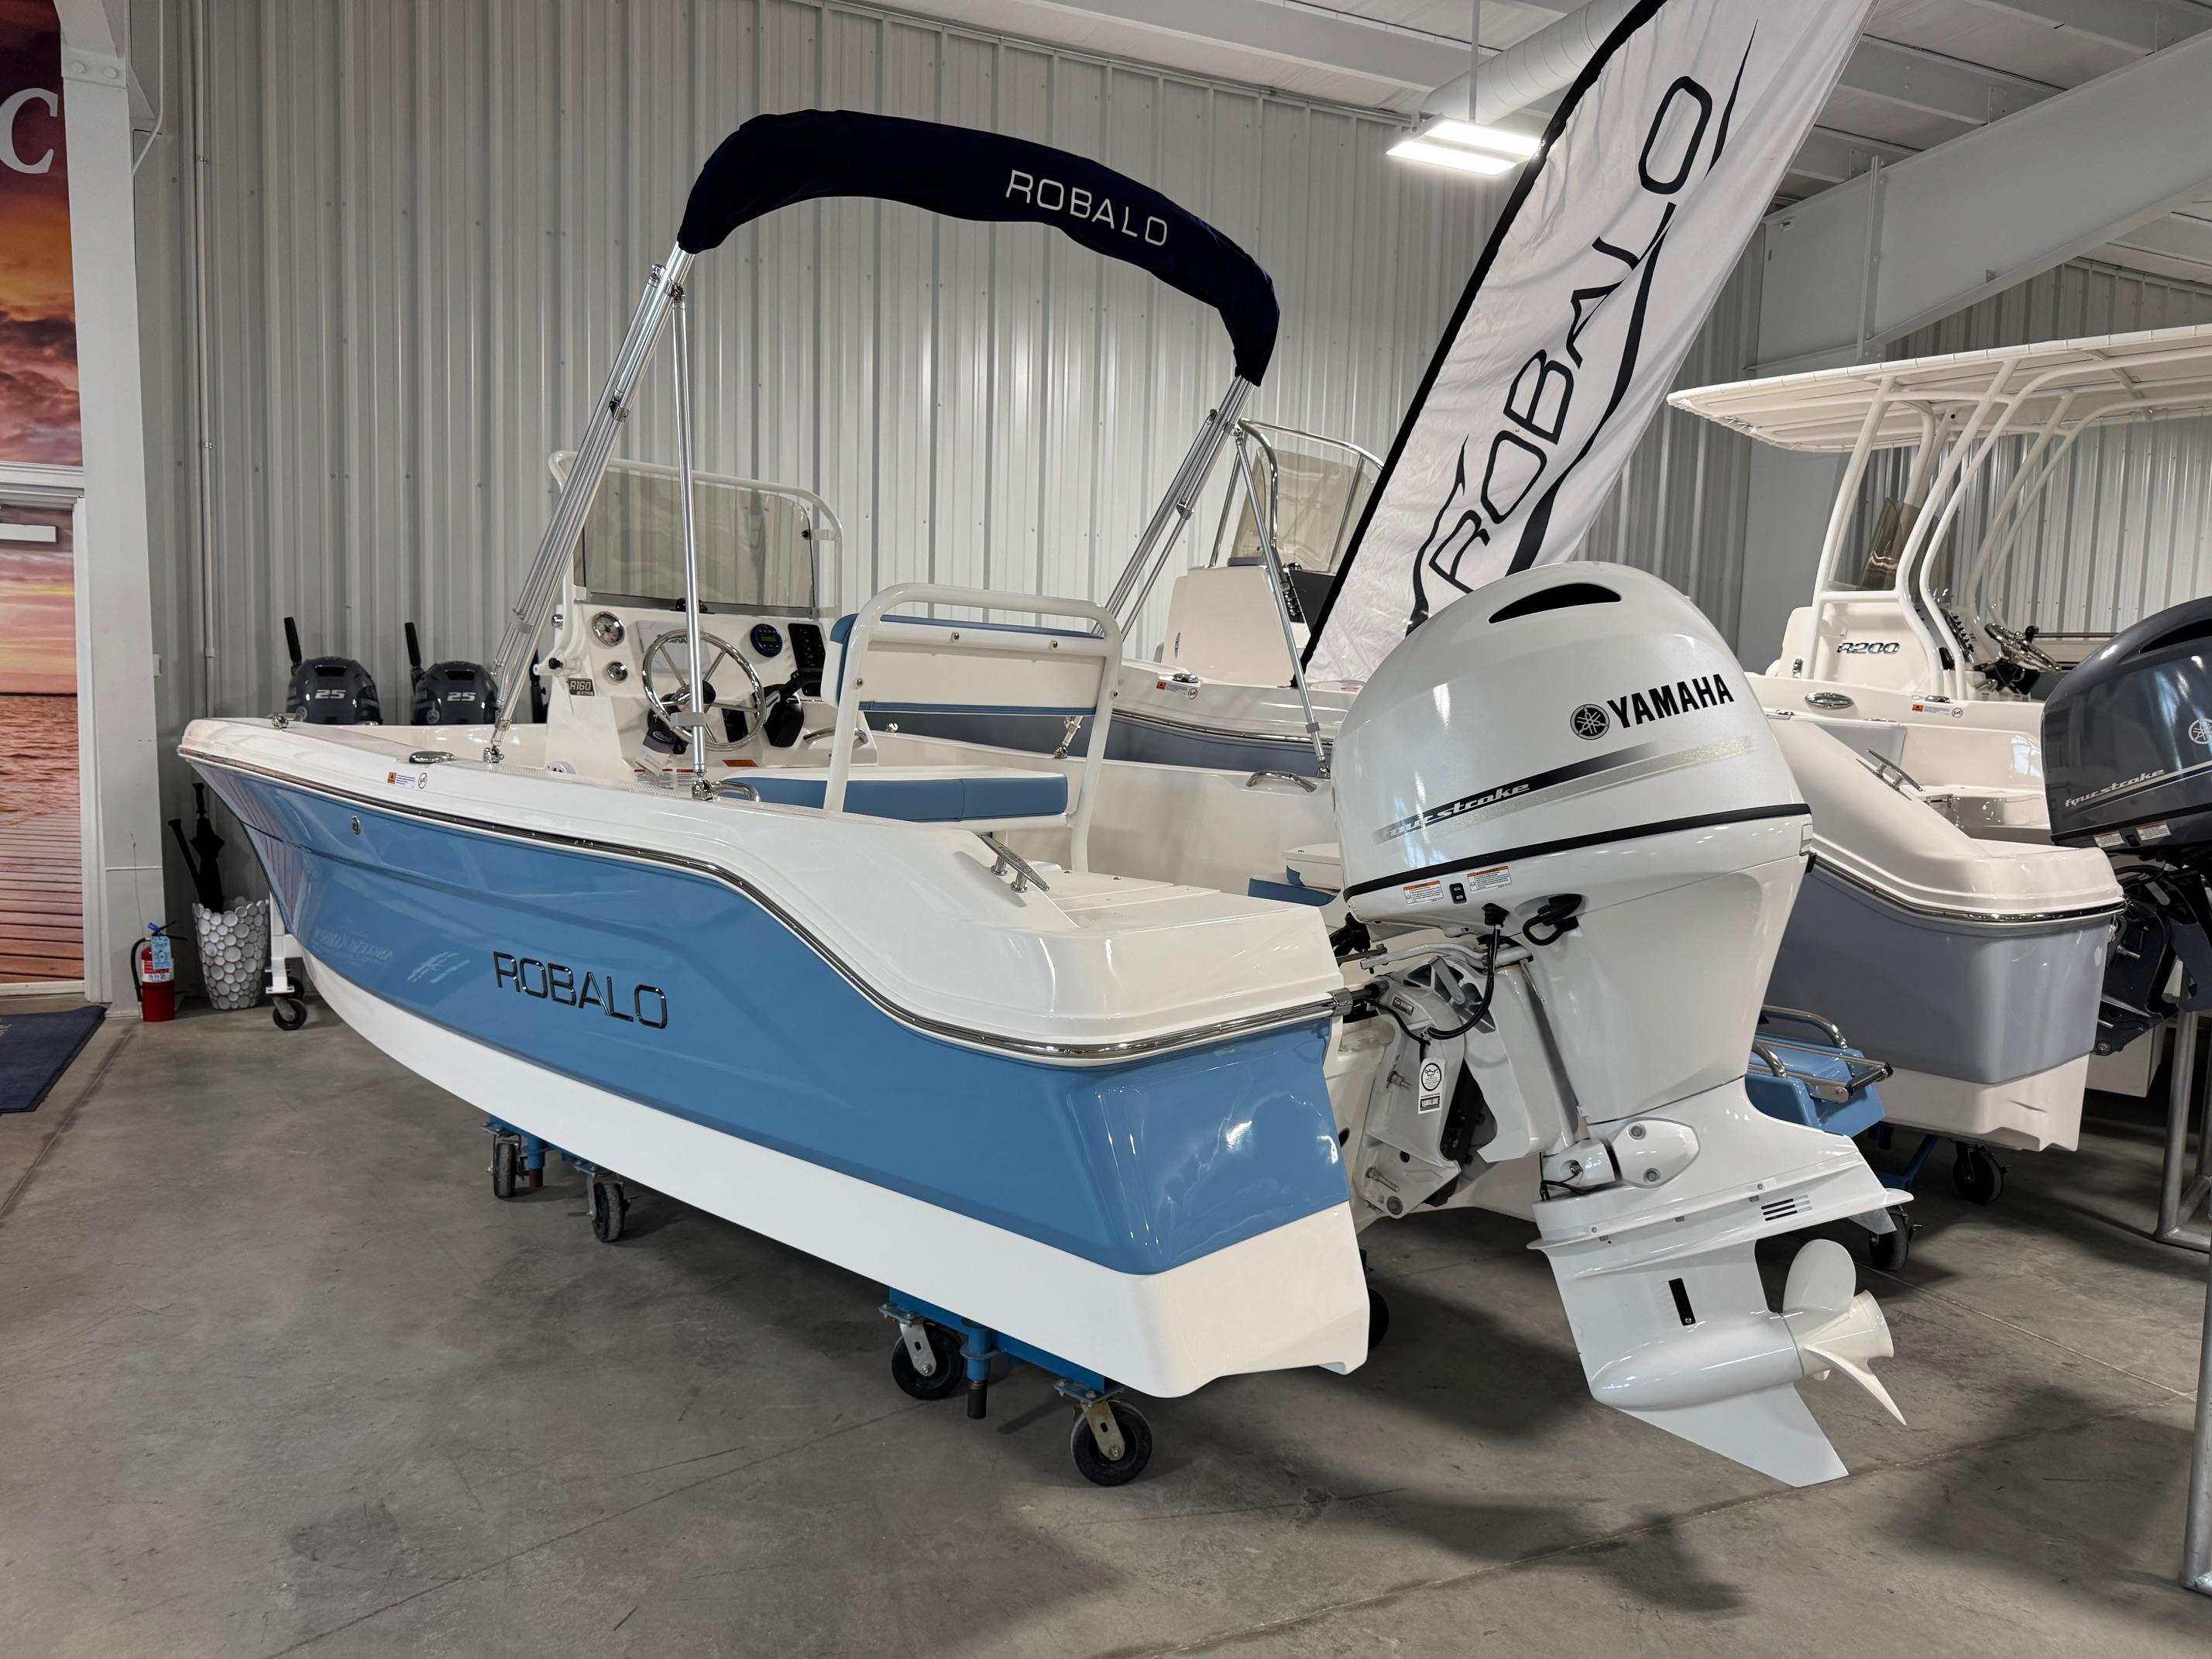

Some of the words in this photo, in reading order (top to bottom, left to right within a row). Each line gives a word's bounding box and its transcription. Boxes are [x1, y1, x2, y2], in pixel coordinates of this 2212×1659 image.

[0, 88, 58, 174] C
[1005, 169, 1168, 246] ROBALO
[1430, 75, 1712, 593] ROBALO
[1836, 642, 1901, 655] R200
[314, 689, 346, 699] 25
[447, 692, 477, 702] 25
[570, 681, 592, 691] R160
[1606, 673, 1735, 729] YAMAHA
[493, 951, 668, 1029] ROBALO
